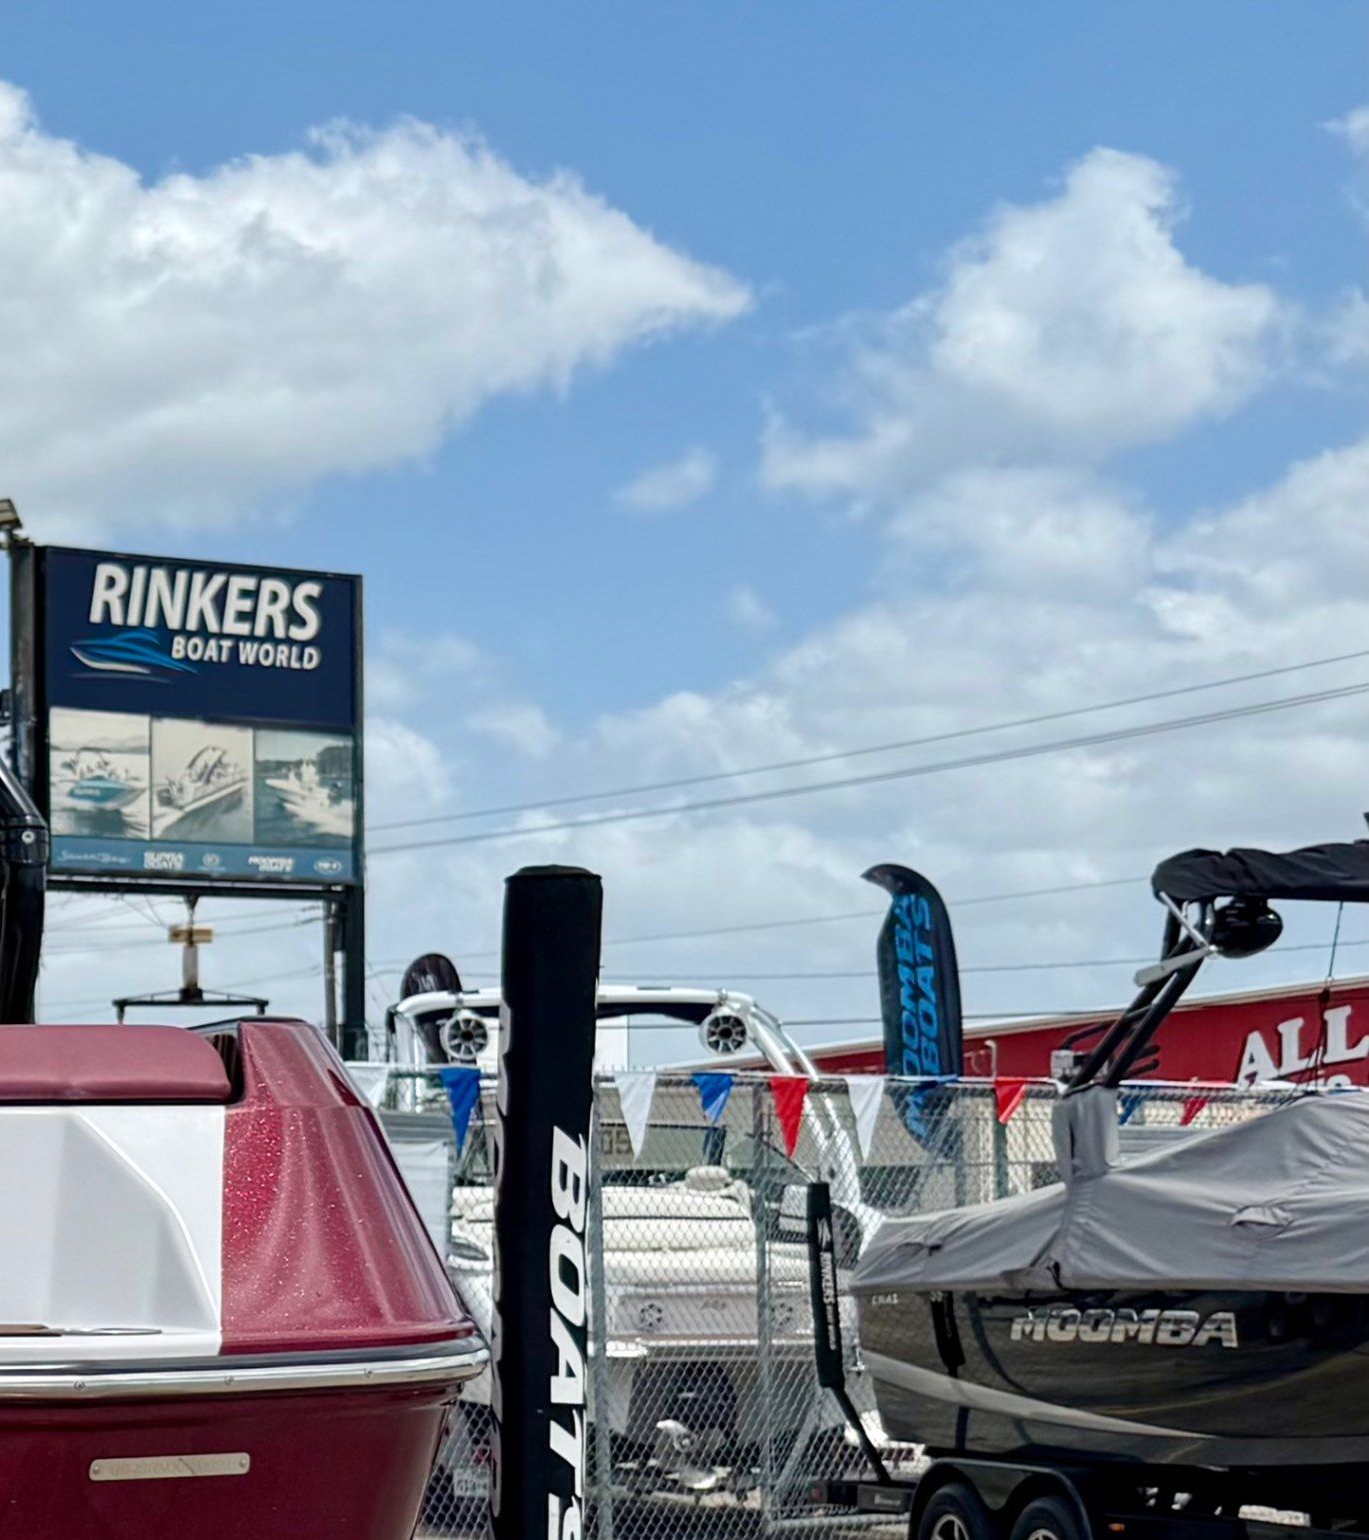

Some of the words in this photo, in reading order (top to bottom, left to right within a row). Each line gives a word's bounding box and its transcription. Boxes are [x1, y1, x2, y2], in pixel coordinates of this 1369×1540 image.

[89, 563, 322, 641] RINKERS
[171, 636, 230, 664] BOAT
[238, 647, 320, 671] WORLD
[912, 896, 942, 1075] BOATS
[1010, 1308, 1238, 1348] MOOMBA
